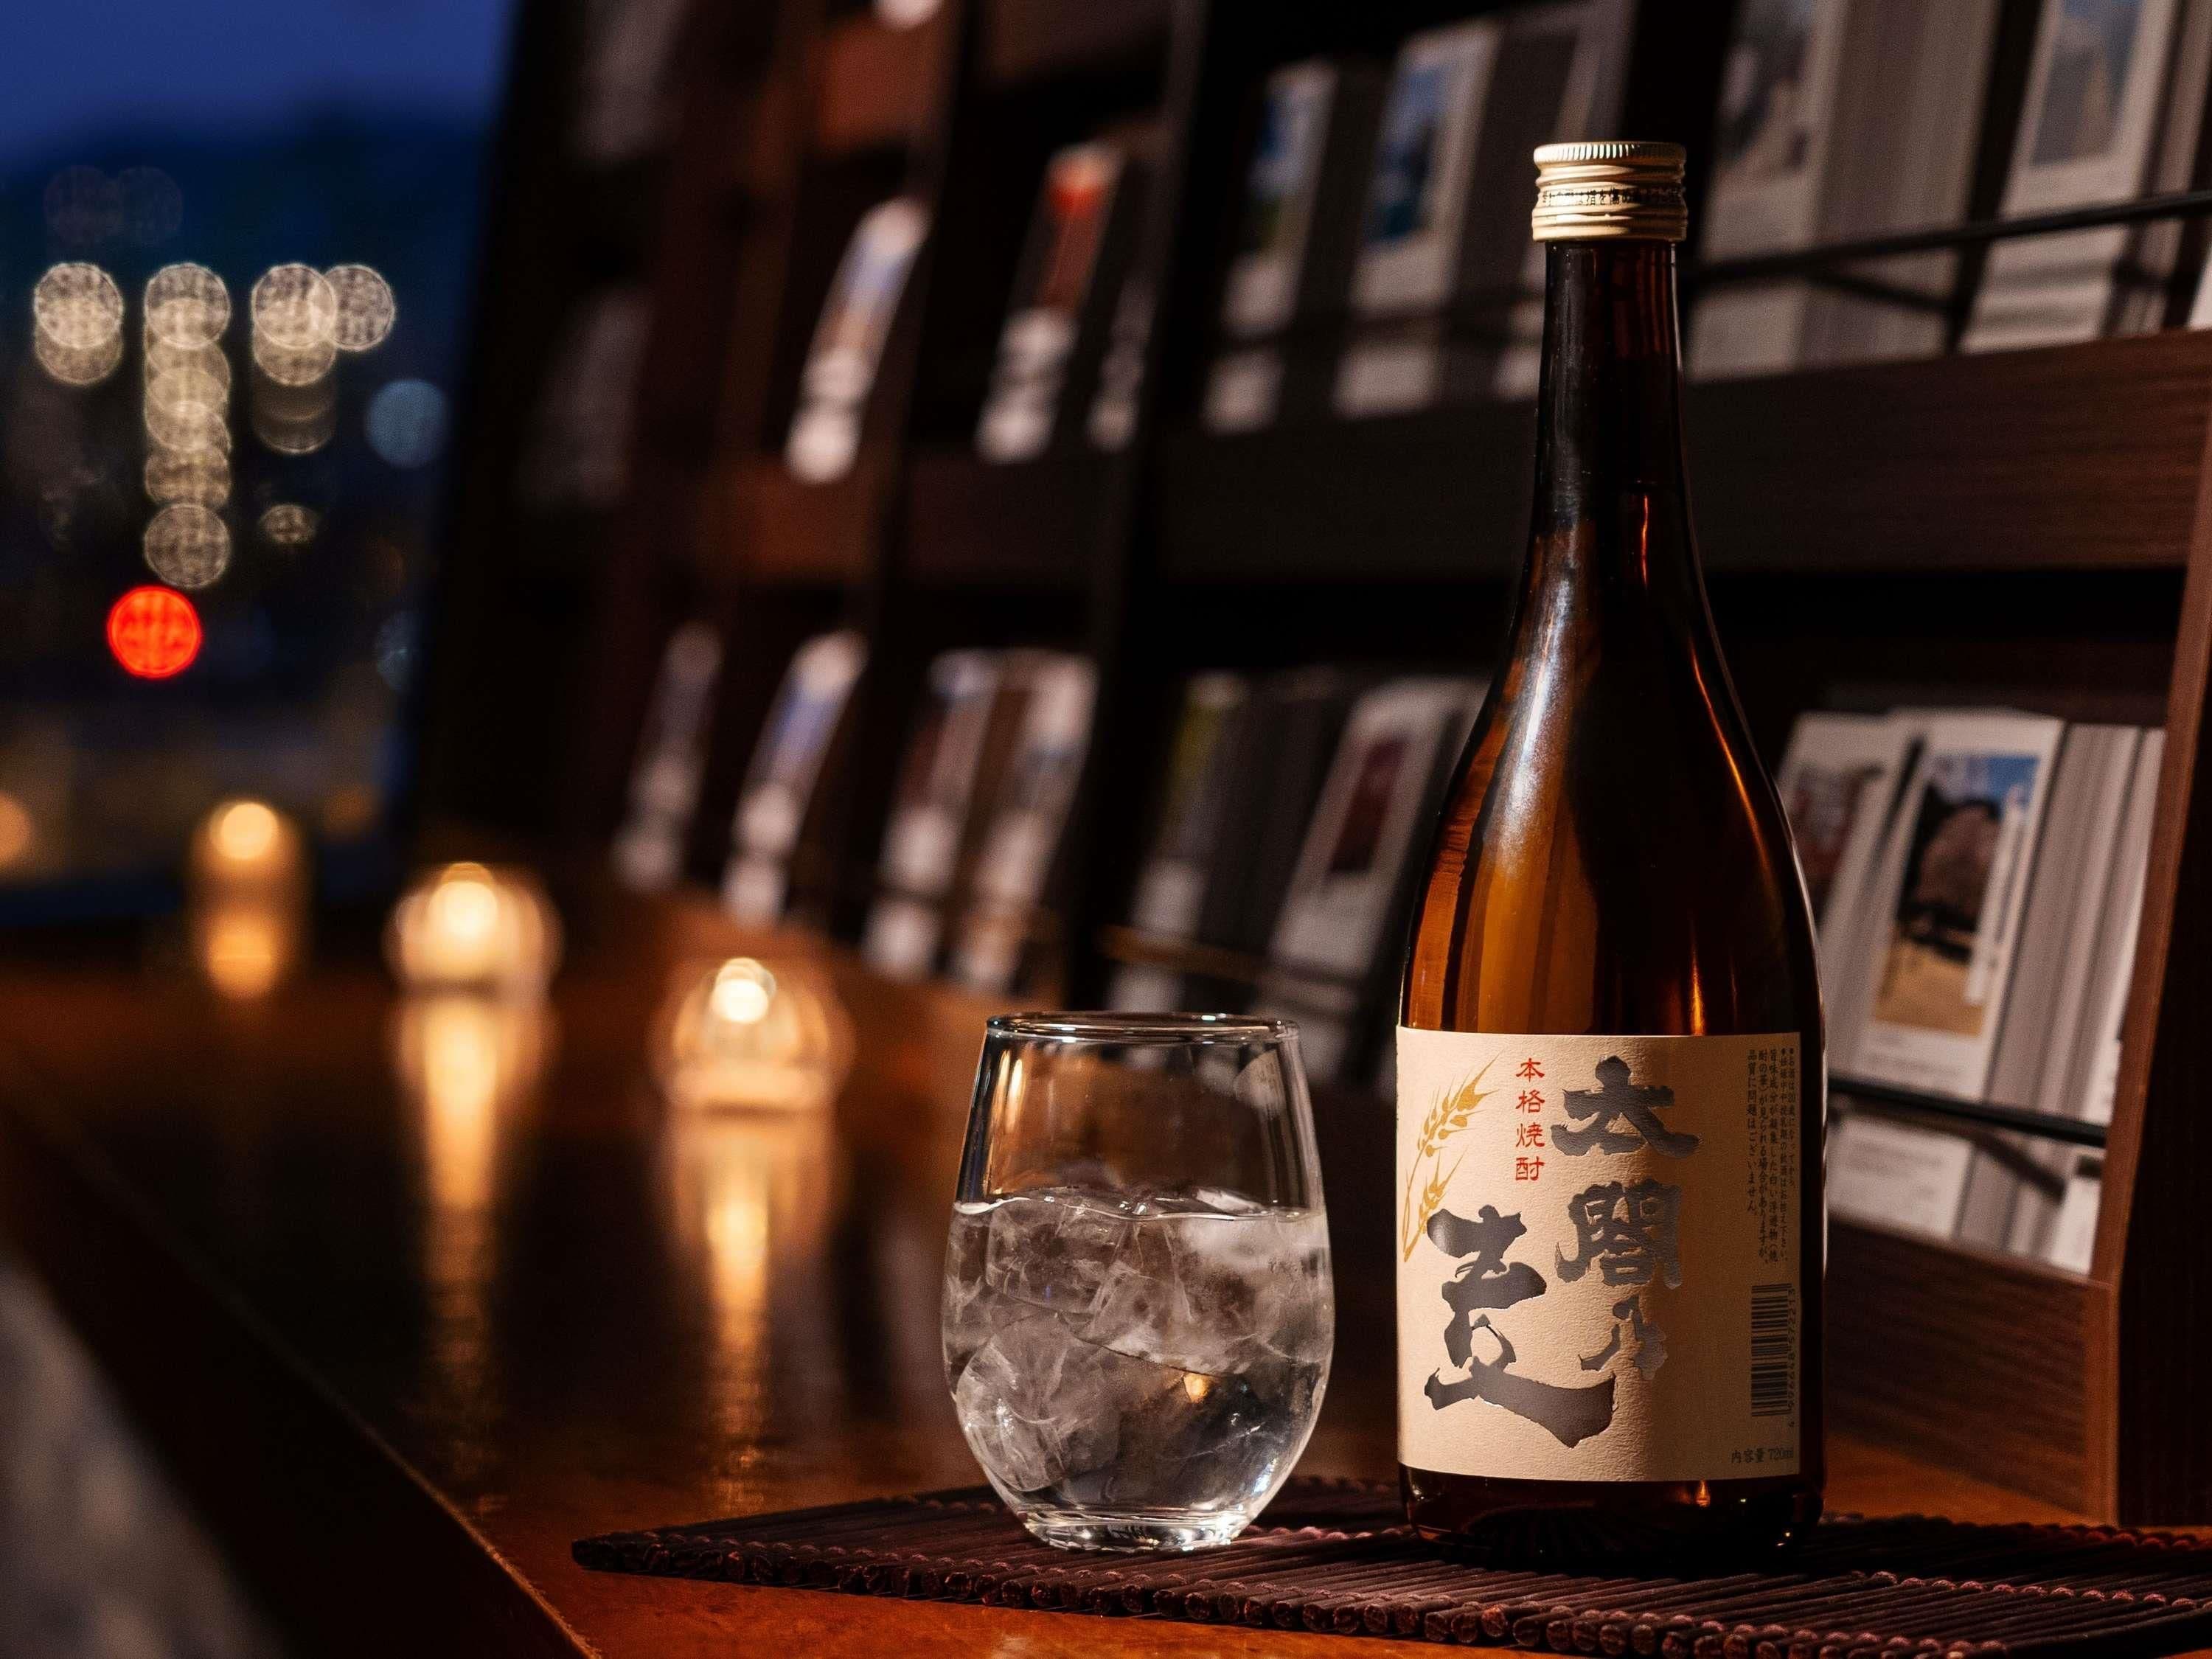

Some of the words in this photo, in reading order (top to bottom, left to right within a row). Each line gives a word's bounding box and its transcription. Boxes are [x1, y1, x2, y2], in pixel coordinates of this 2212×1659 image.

[1514, 1057, 1546, 1181] 本格焼酎
[1731, 1447, 1764, 1464] 内容量
